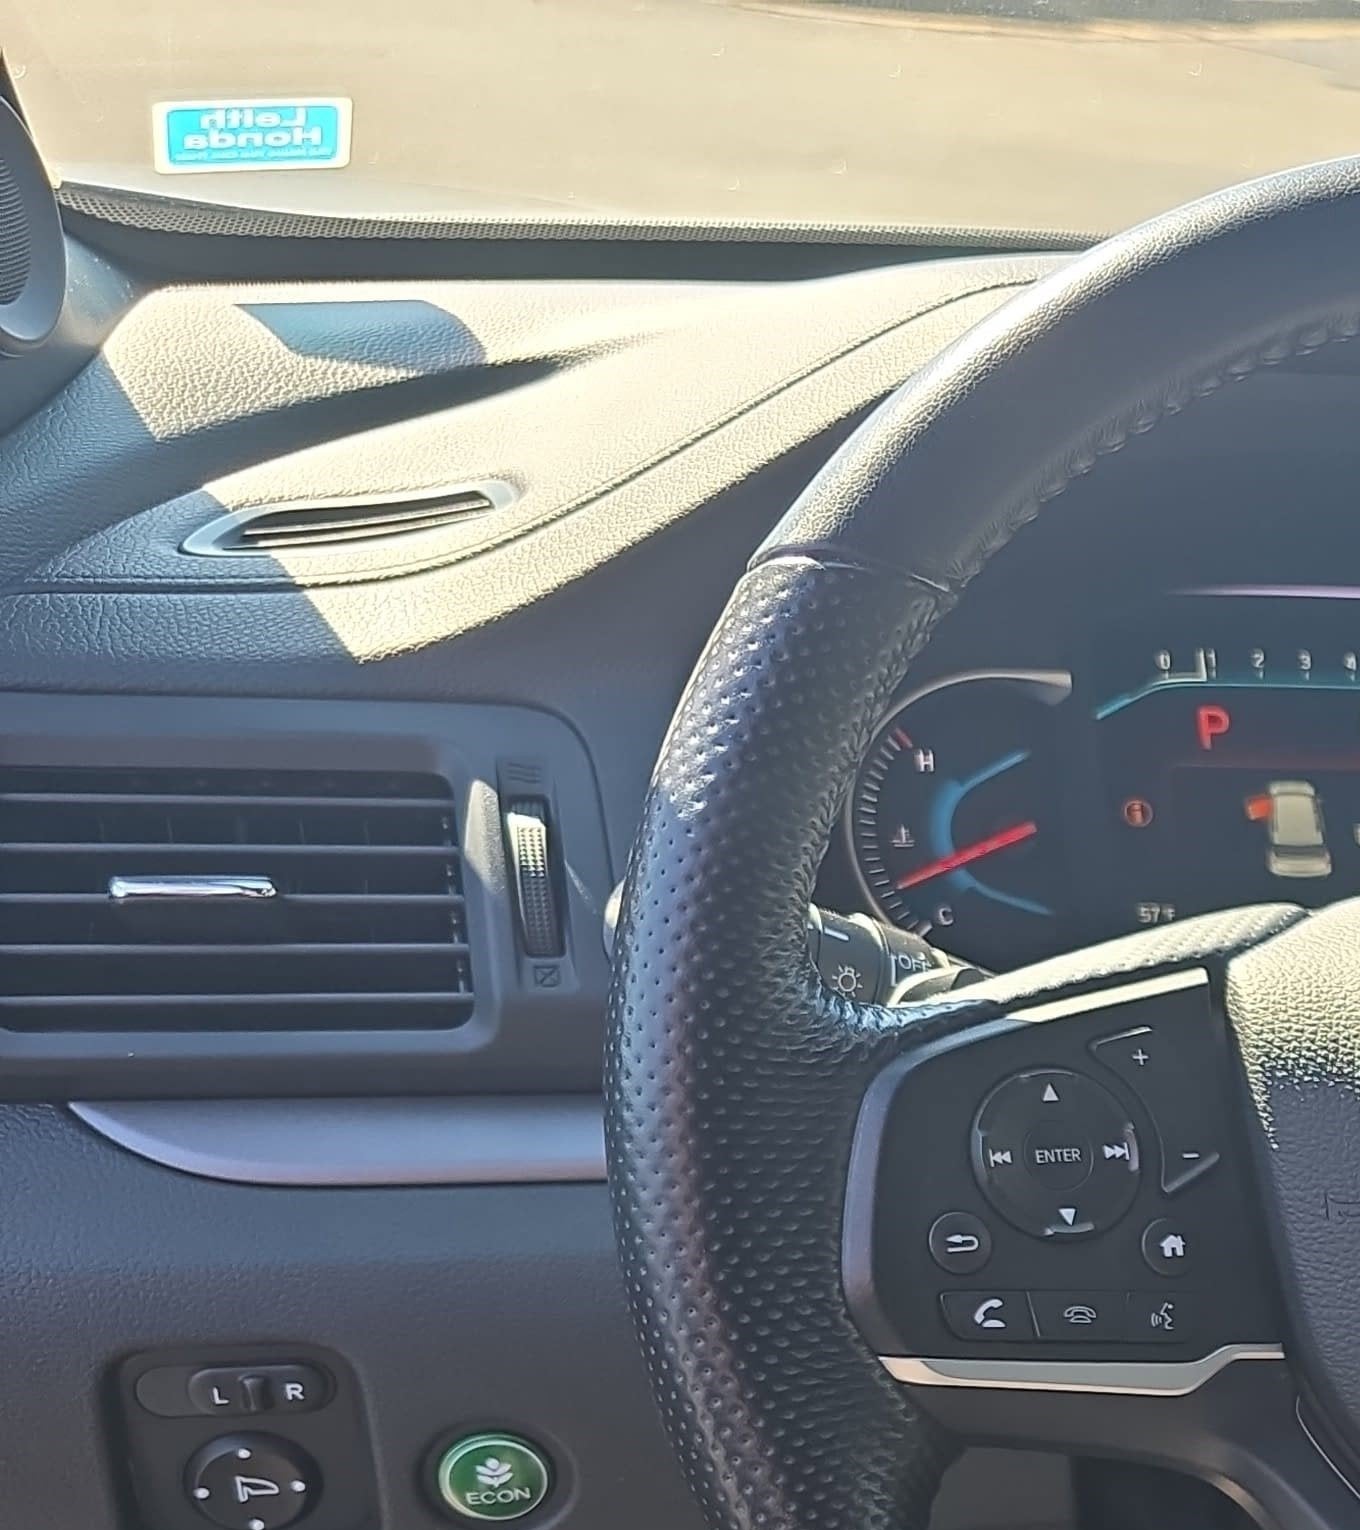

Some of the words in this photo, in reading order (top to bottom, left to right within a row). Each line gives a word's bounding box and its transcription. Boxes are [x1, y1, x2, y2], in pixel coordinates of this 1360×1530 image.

[1252, 648, 1266, 669] 2
[1299, 650, 1313, 671] 3
[1343, 652, 1358, 671] 4
[1197, 704, 1230, 750] P
[914, 749, 936, 773] H
[935, 907, 955, 927] C
[1034, 1147, 1082, 1165] ENTER
[212, 1386, 229, 1405] L
[285, 1383, 304, 1401] R
[464, 1486, 531, 1507] ECON
